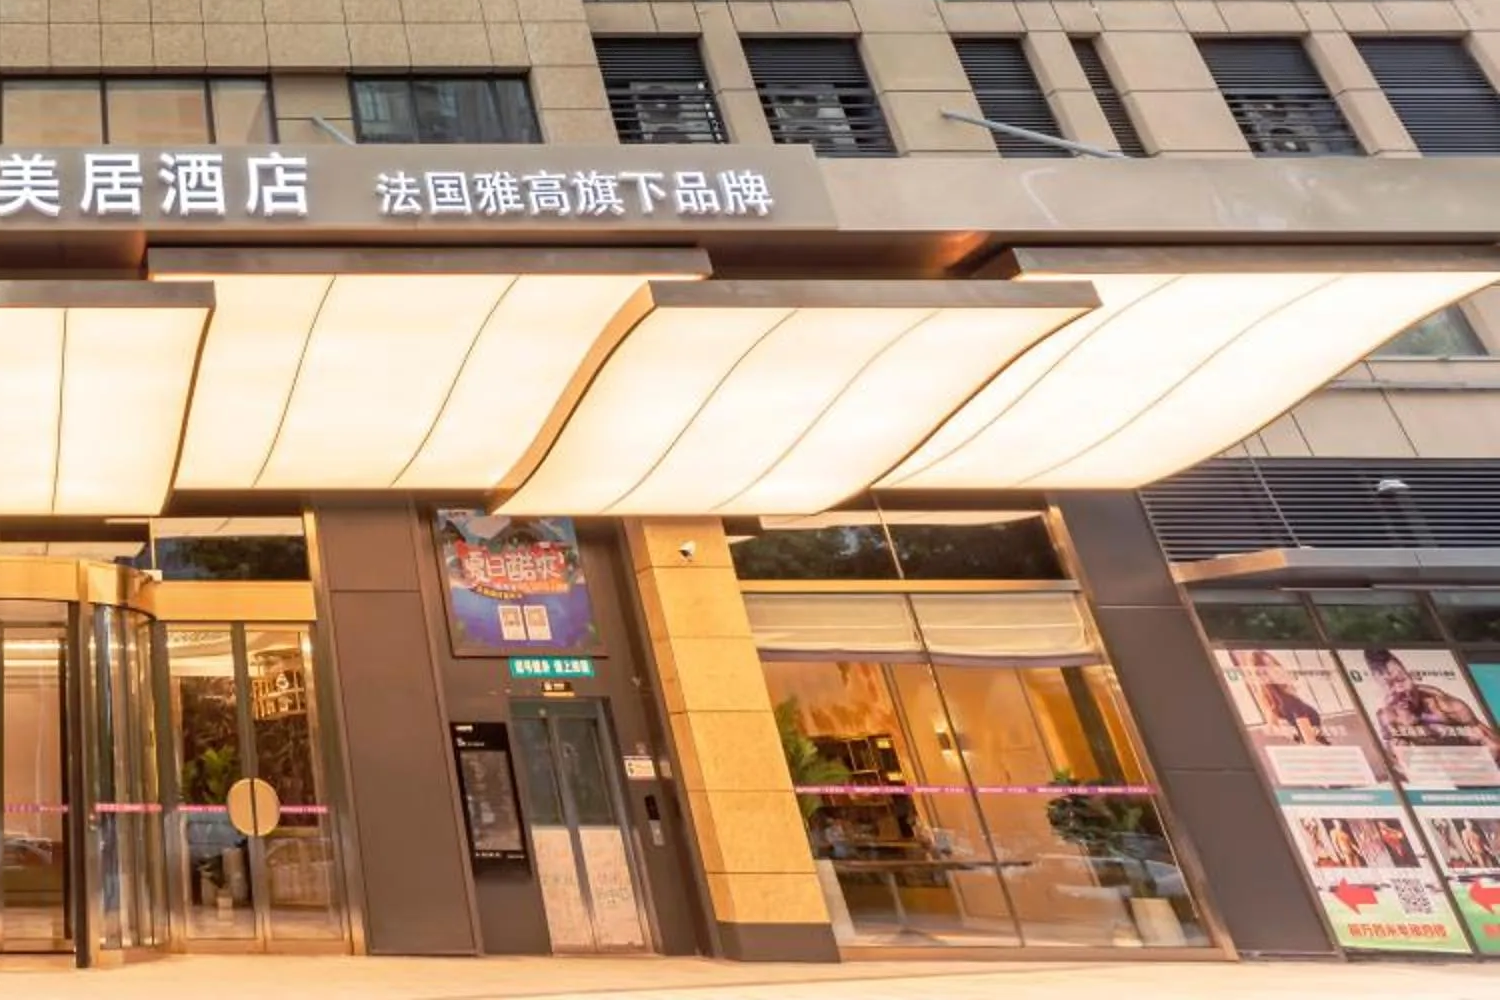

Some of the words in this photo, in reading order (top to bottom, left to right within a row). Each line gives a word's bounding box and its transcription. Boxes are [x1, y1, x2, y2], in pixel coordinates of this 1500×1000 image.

[376, 170, 773, 216] 法国雅高旗下品牌
